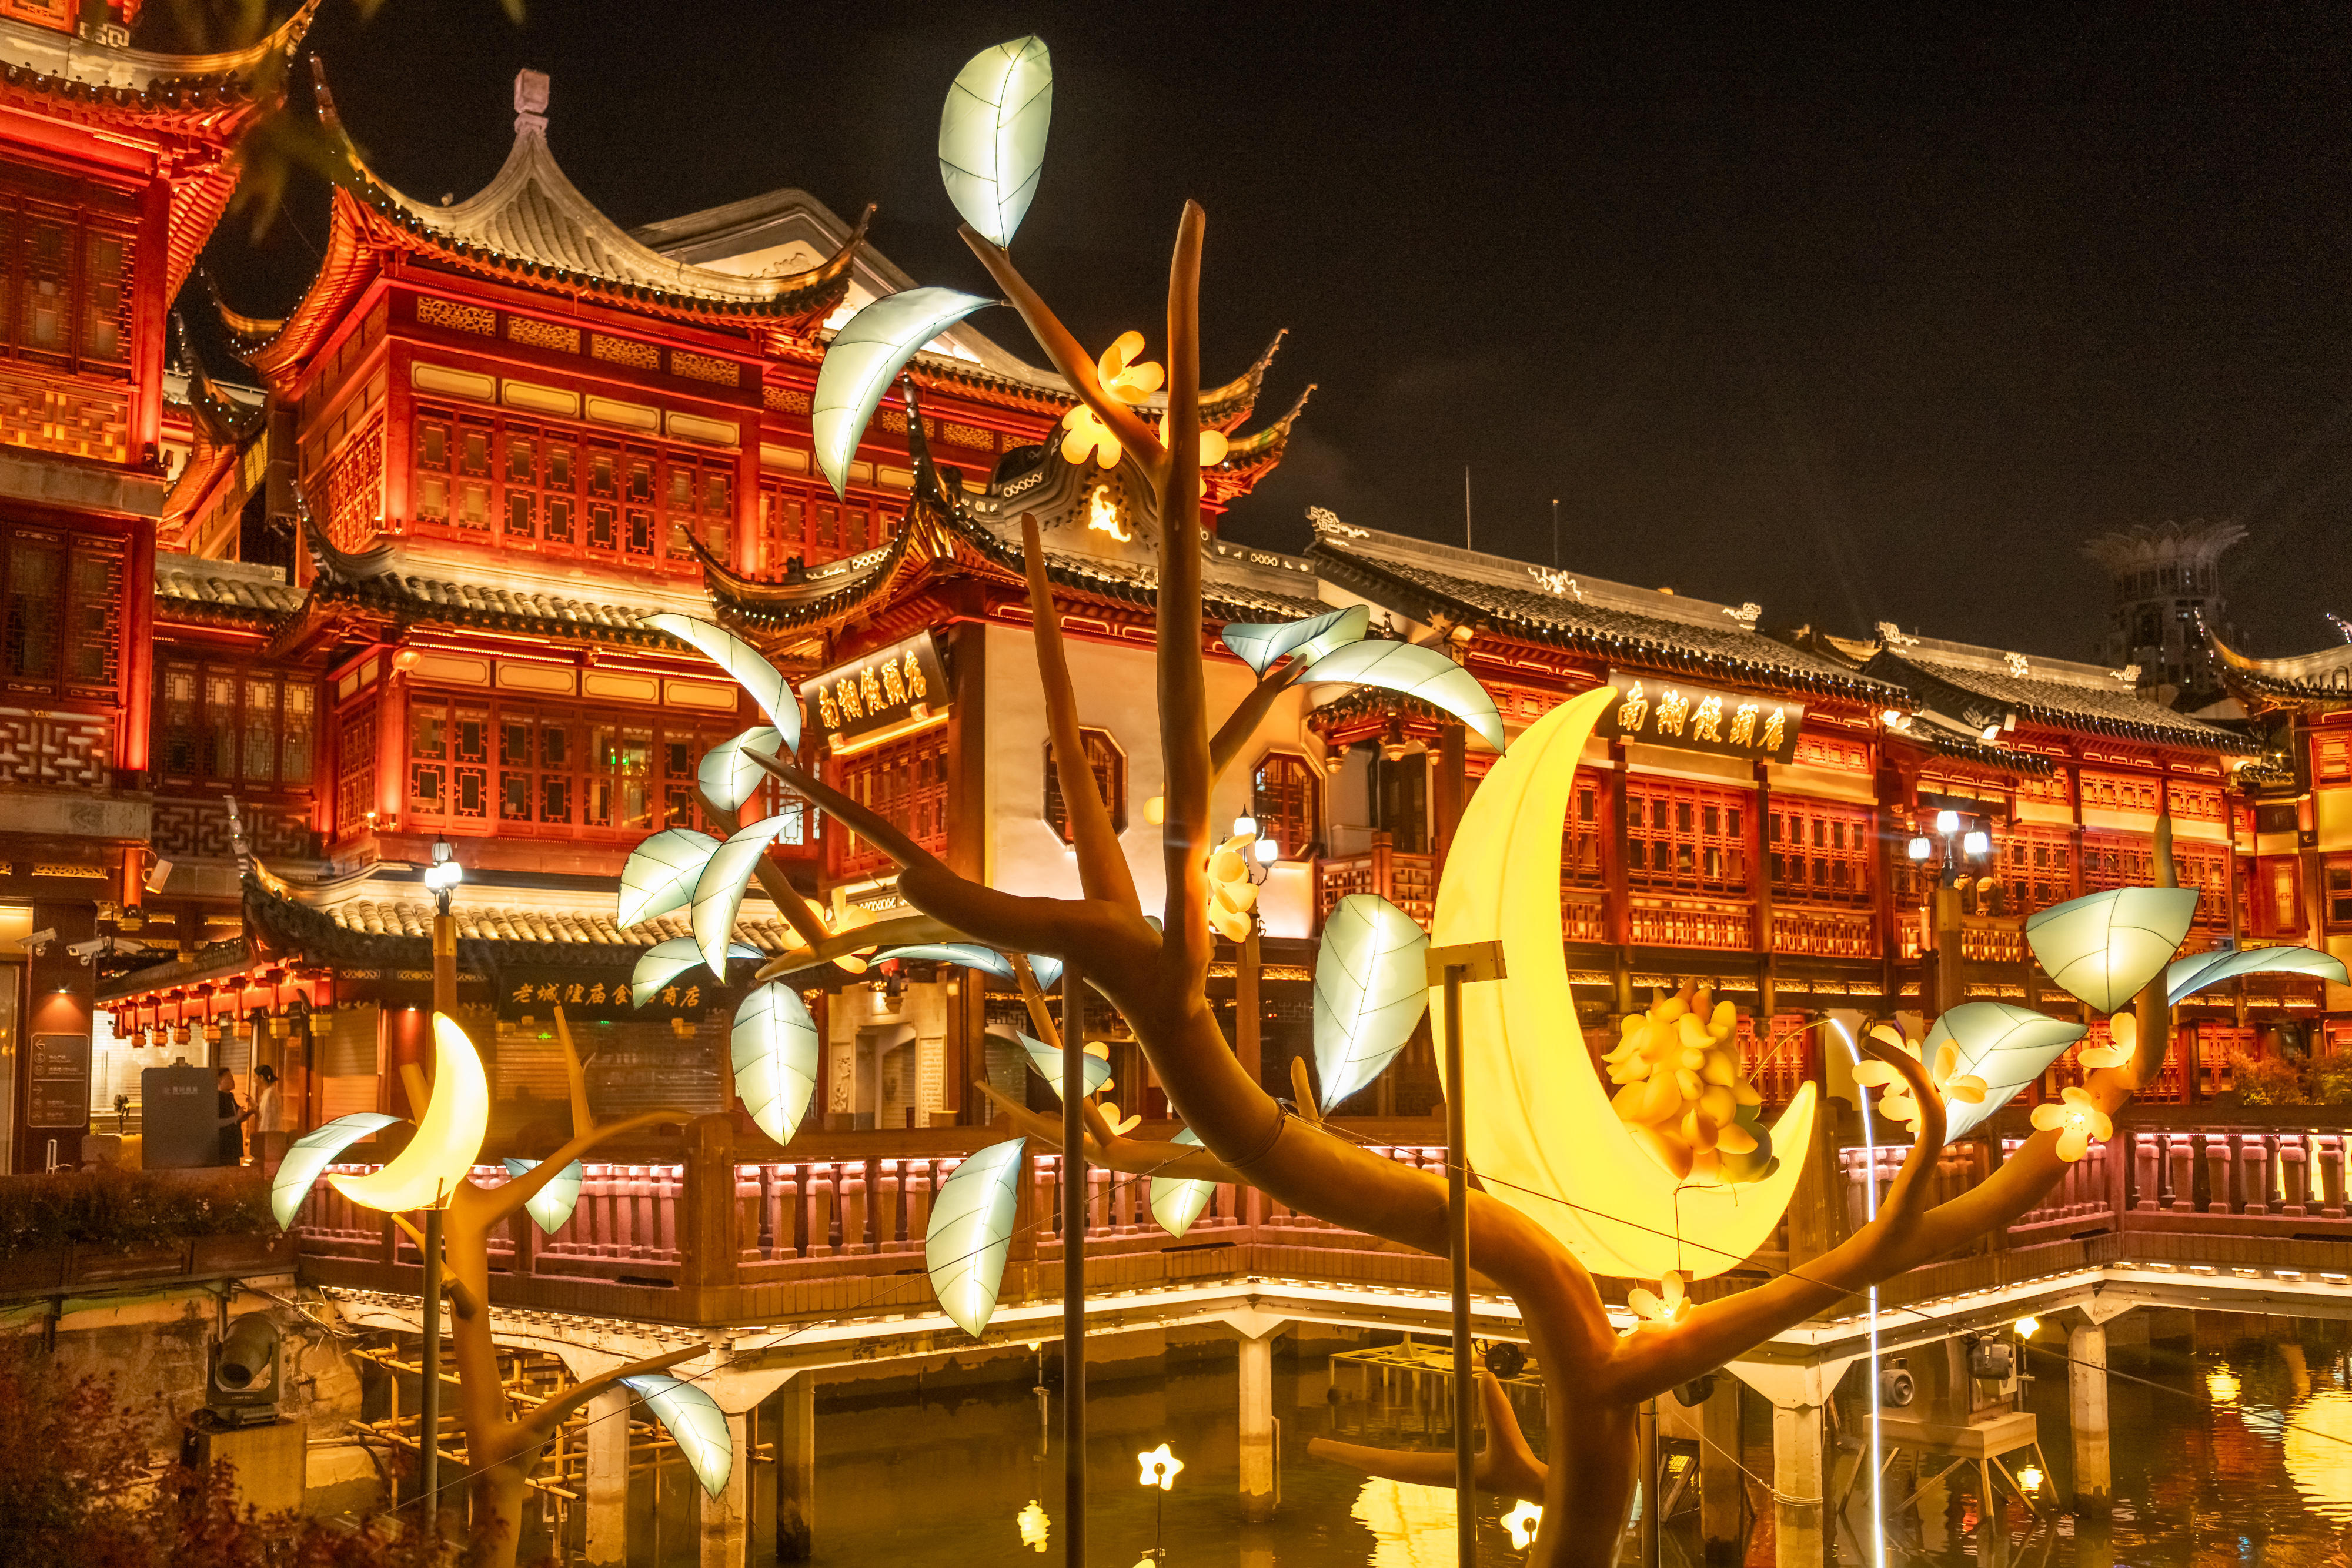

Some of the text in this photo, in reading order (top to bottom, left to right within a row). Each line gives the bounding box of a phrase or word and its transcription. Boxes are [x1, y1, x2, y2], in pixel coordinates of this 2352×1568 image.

[512, 982, 700, 1007] 老城隍庙食商店
